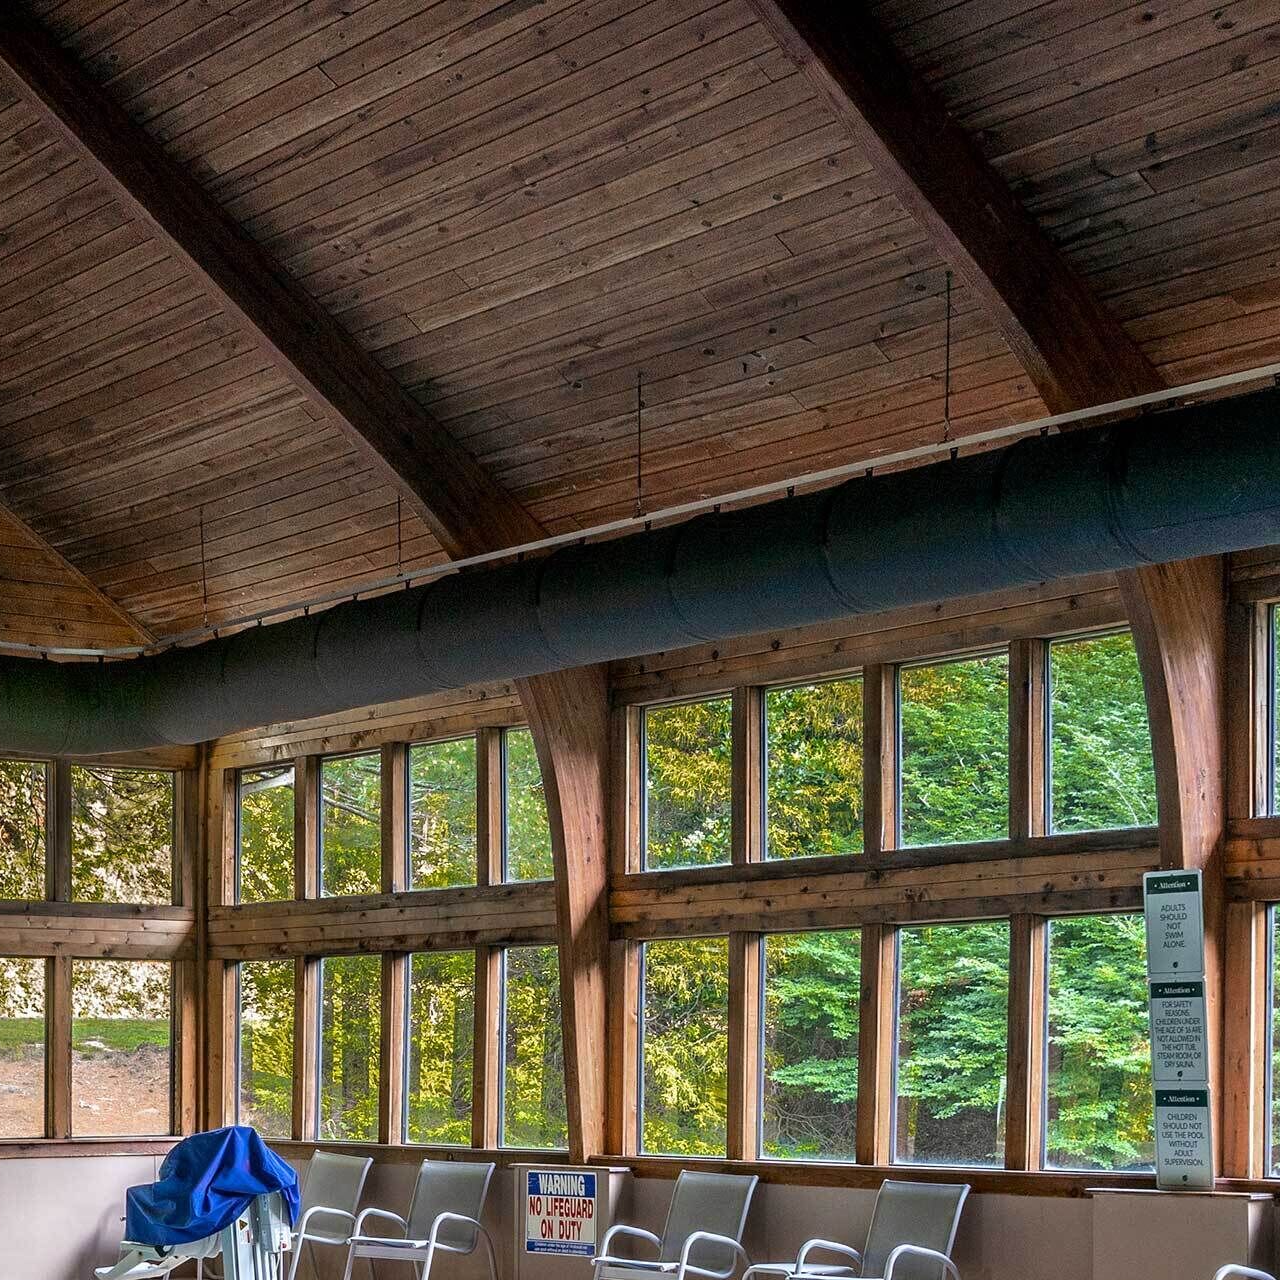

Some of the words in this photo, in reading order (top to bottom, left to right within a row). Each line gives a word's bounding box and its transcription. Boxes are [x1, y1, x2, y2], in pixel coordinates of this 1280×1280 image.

[1159, 881, 1186, 889] Attention
[1161, 904, 1186, 912] ADULTS
[1160, 913, 1187, 921] SHOULD
[1166, 922, 1181, 930] NOT
[1165, 931, 1184, 939] SWIM
[1182, 1017, 1200, 1025] UNDER
[1155, 1026, 1165, 1034] THE
[1166, 1026, 1176, 1034] AGE
[1177, 1026, 1184, 1034] OF
[1161, 1043, 1172, 1051] THE
[1168, 1095, 1195, 1103] Attention
[1167, 1113, 1198, 1121] CHILDREN
[1162, 1122, 1188, 1130] SHOULD
[1189, 1122, 1202, 1130] NOT
[1161, 1131, 1173, 1139] USE
[1174, 1131, 1186, 1139] THE
[1188, 1131, 1205, 1139] POOL
[1168, 1140, 1198, 1148] WITHOUT
[1174, 1149, 1193, 1157] ADULT
[538, 1174, 586, 1196] WARNING
[529, 1196, 542, 1216] NO
[546, 1197, 594, 1219] LIFEGUARD
[541, 1219, 553, 1239] ON
[559, 1220, 582, 1240] DUTY
